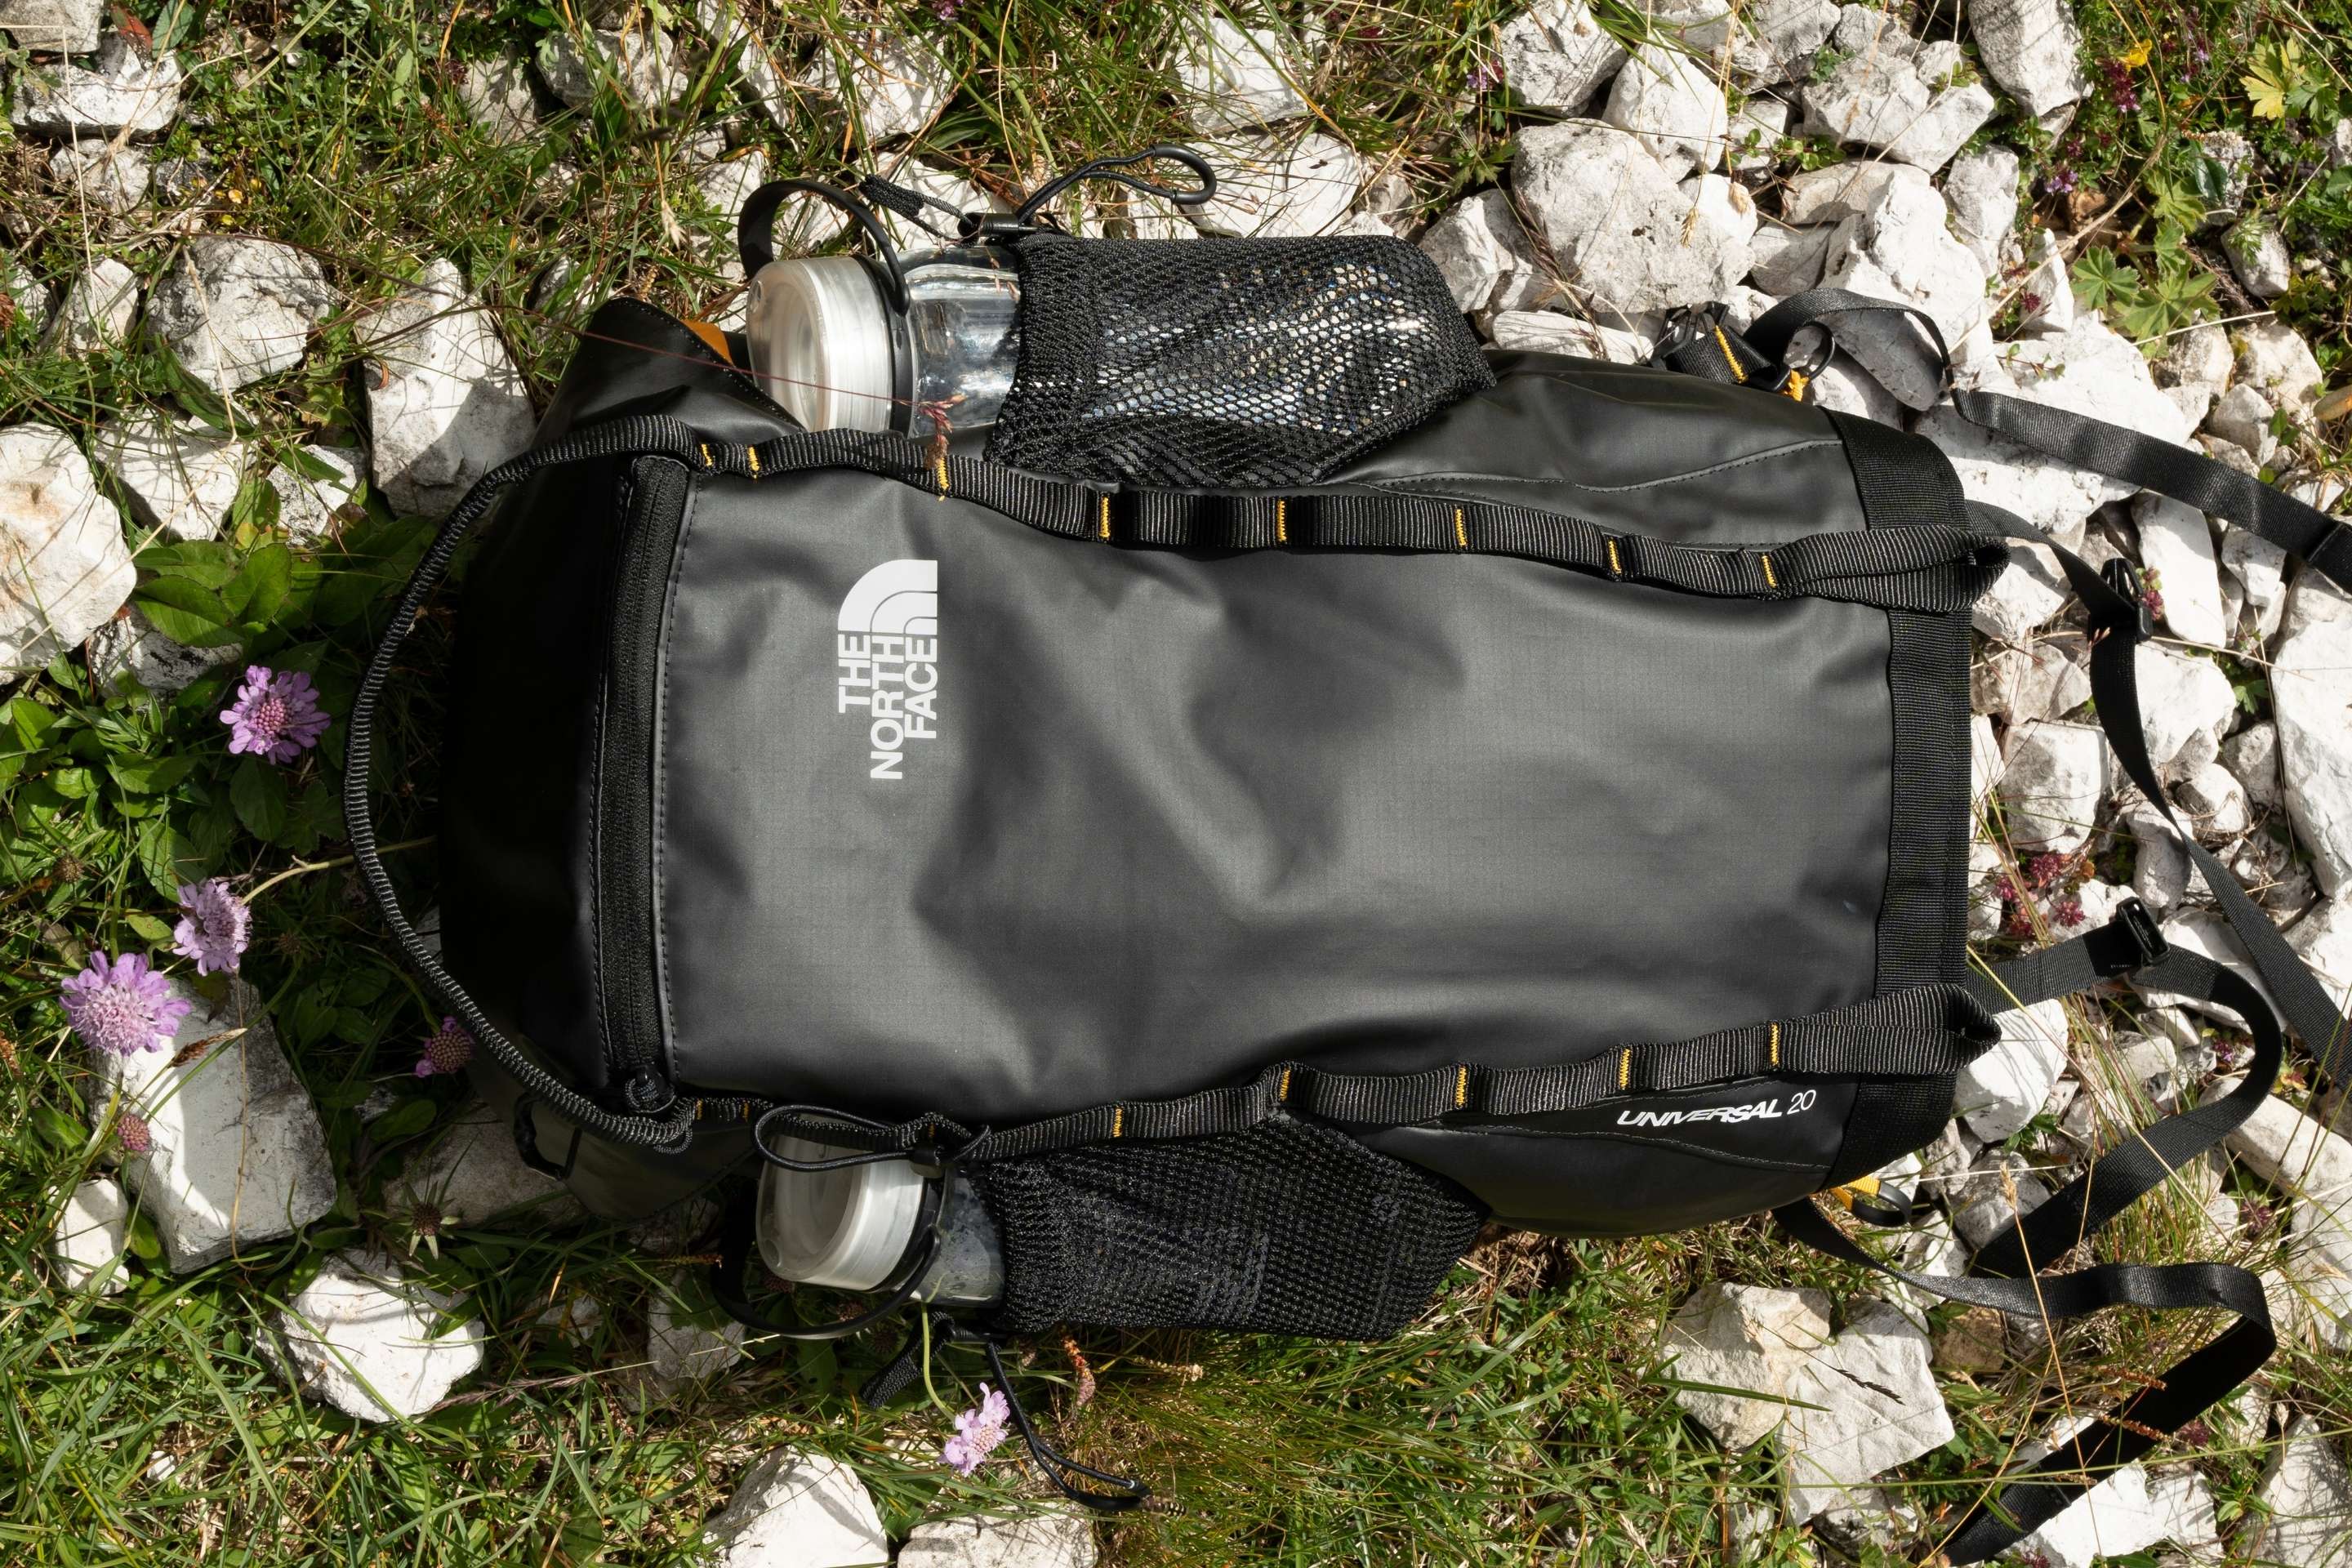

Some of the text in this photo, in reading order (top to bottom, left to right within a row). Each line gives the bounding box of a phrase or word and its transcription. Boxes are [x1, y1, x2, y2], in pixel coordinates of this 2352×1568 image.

[838, 634, 871, 713] THE
[870, 635, 904, 779] NORTH
[904, 637, 938, 739] FACE
[1616, 1089, 1817, 1127] UNIVERSAL 20
